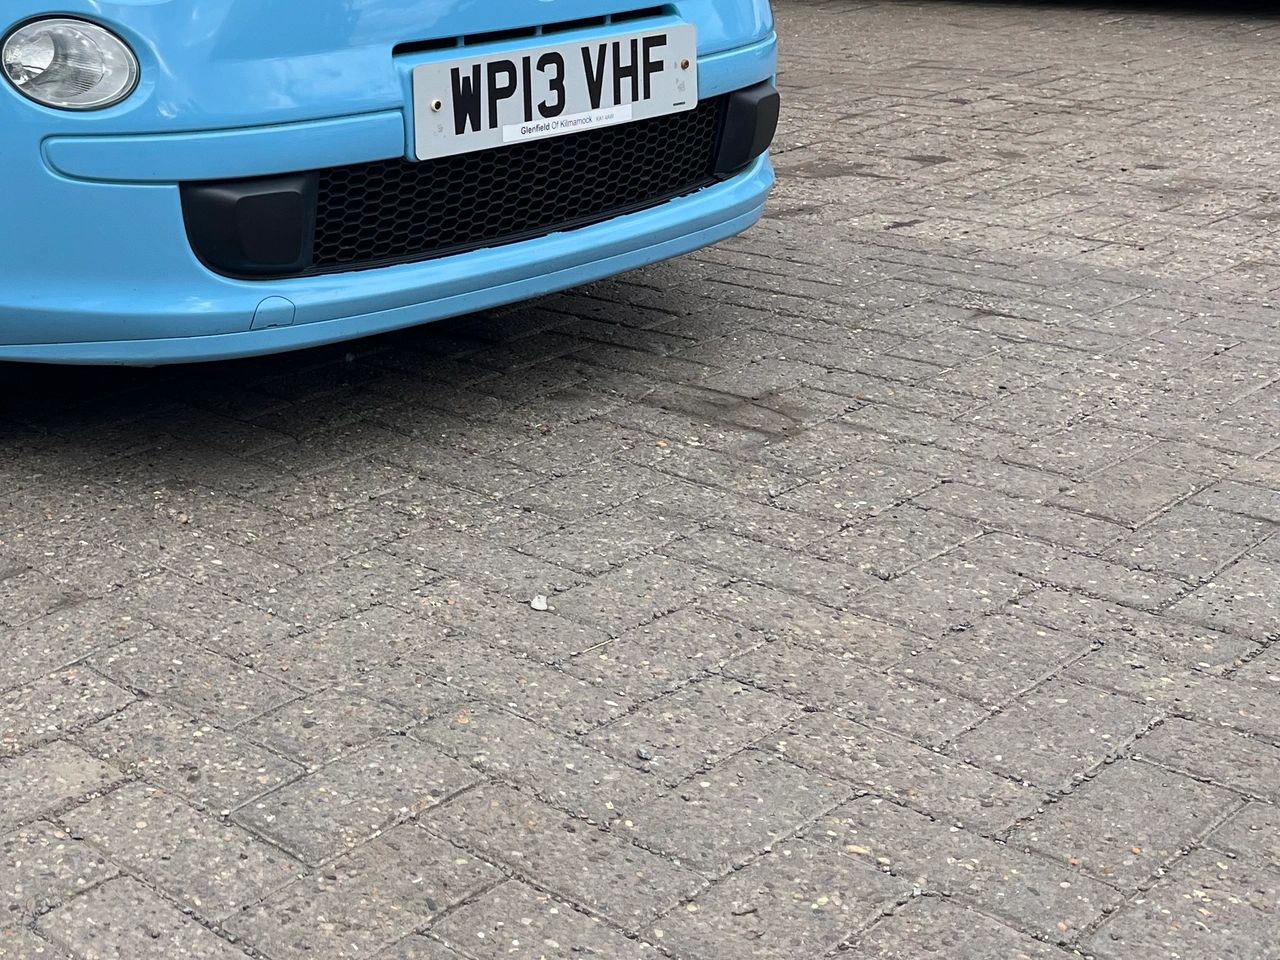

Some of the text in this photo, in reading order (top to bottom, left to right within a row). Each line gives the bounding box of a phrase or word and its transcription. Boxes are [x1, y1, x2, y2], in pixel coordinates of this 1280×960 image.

[449, 33, 668, 136] WP13 VHF
[520, 122, 550, 135] Glenfield
